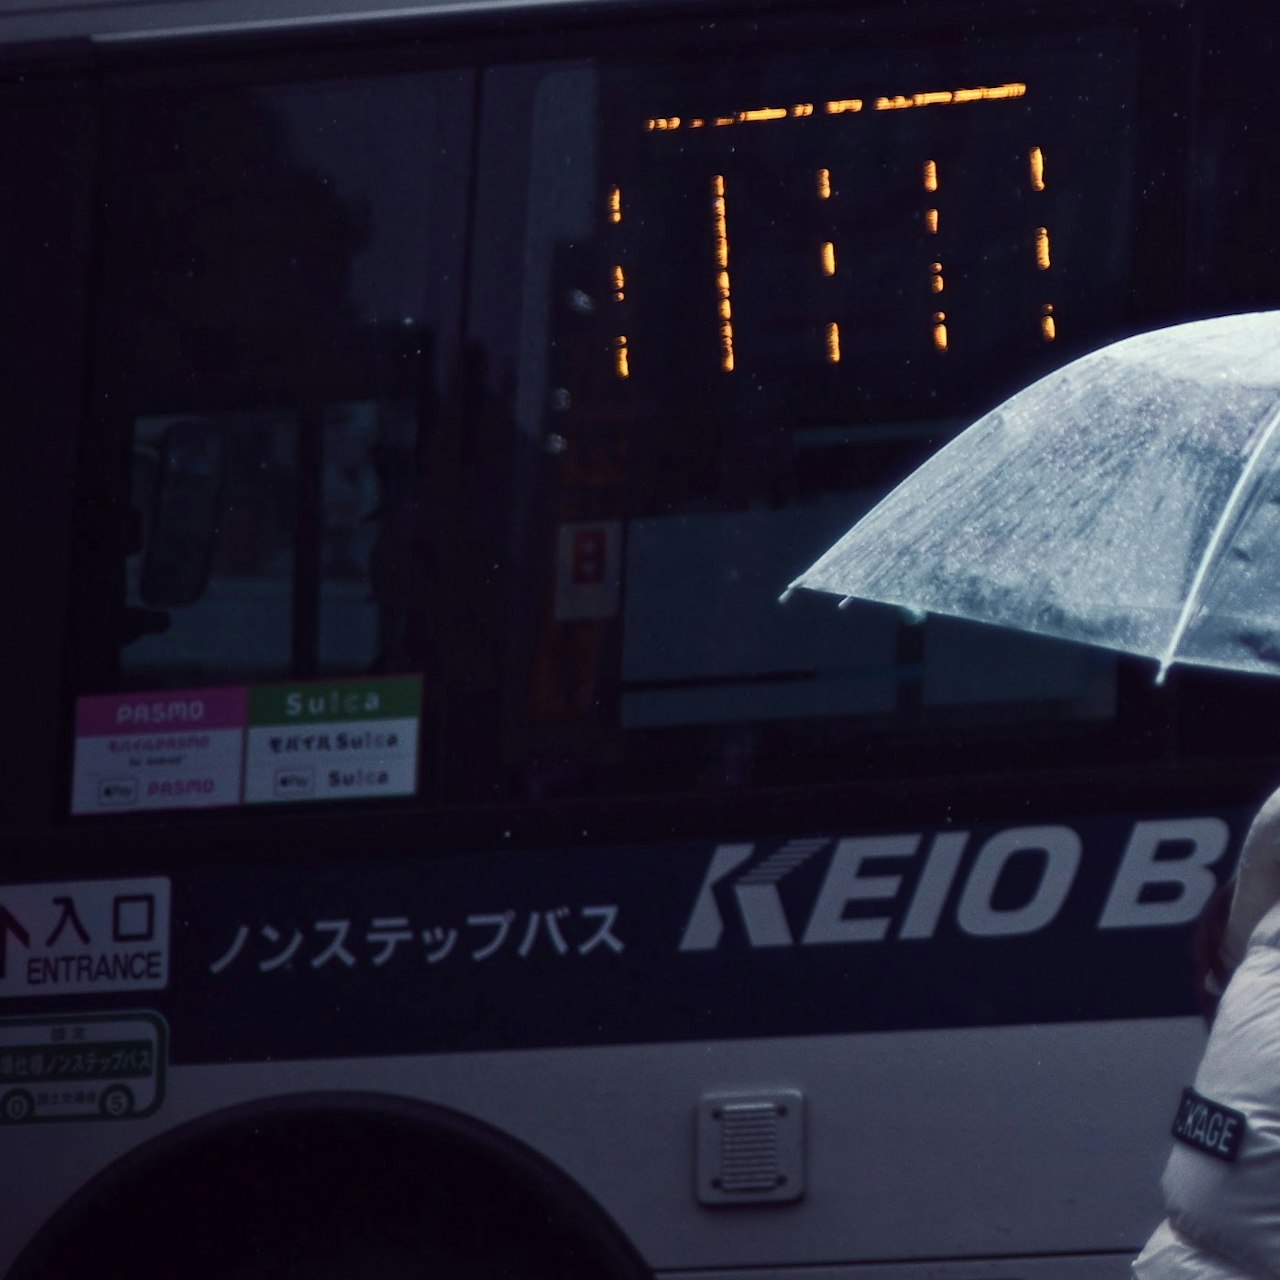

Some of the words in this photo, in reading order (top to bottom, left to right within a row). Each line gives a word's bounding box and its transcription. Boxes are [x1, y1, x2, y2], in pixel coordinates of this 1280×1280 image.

[116, 700, 204, 725] PASMO
[286, 689, 380, 716] Suica
[147, 778, 215, 795] PASMO
[328, 770, 388, 787] Suica
[677, 823, 1083, 952] KEIO
[1096, 816, 1231, 931] B
[46, 894, 154, 946] 入口
[209, 904, 625, 975] ノンステップバス
[27, 951, 161, 985] ENTRANCE
